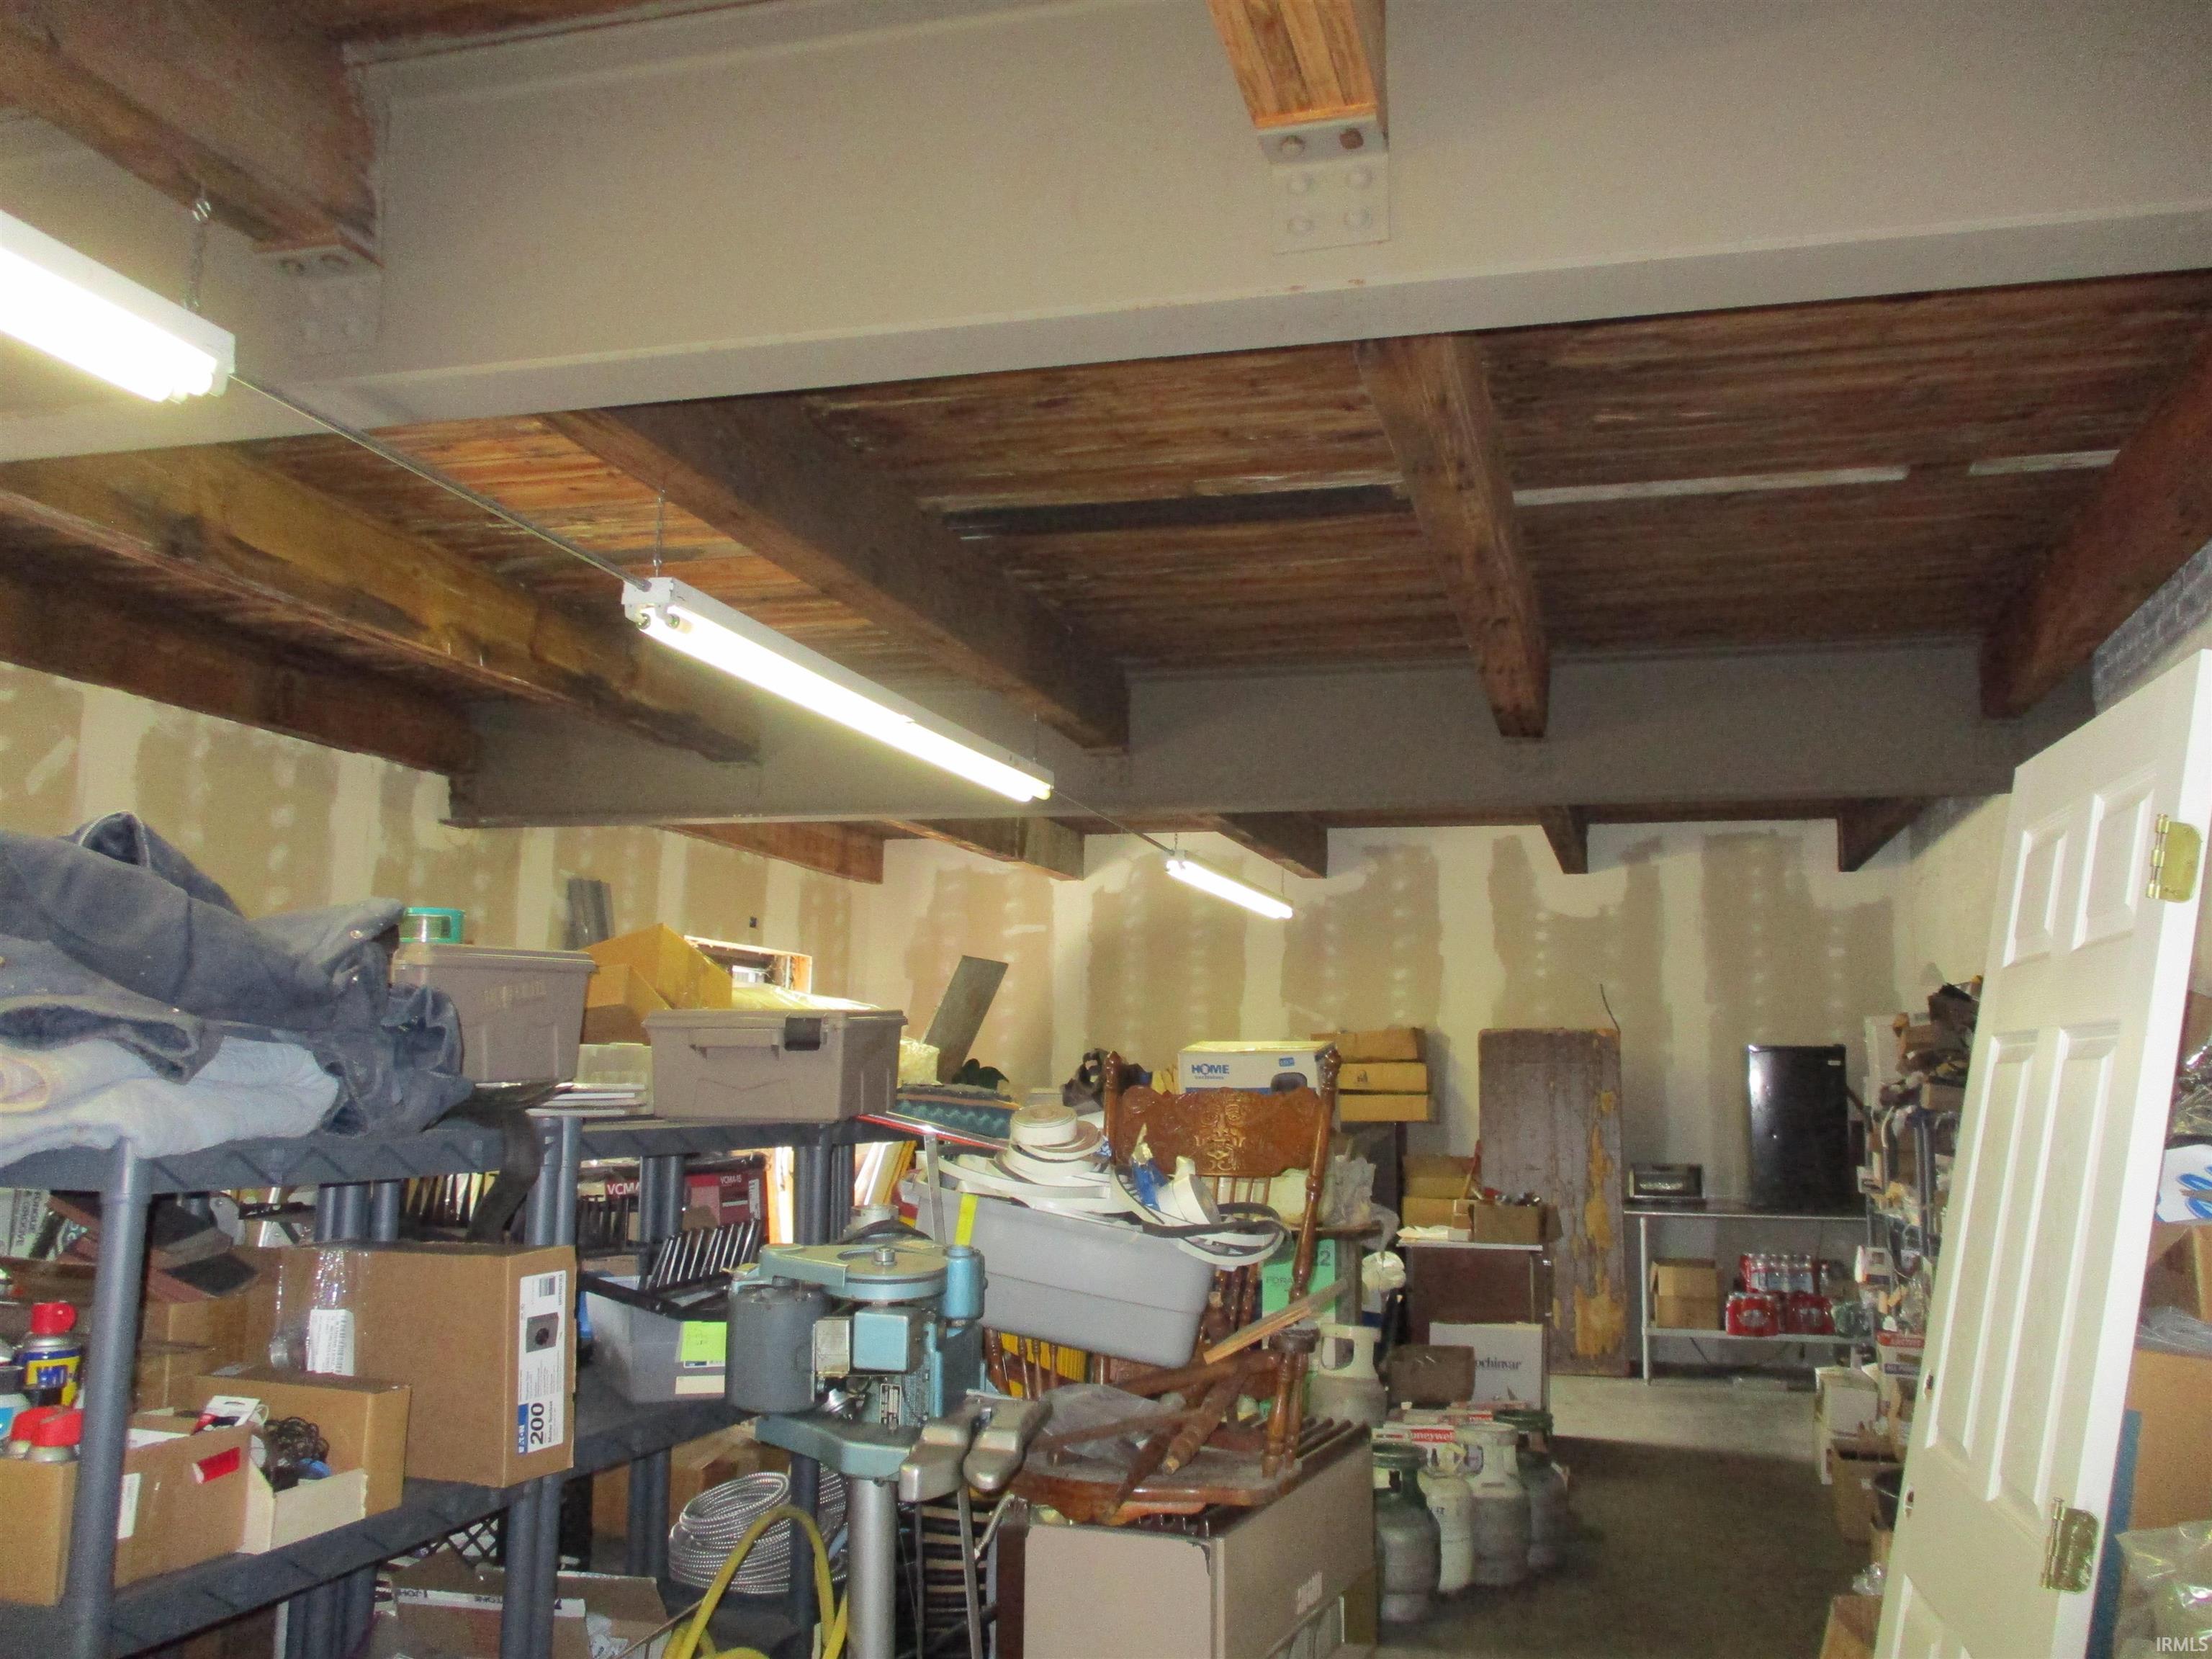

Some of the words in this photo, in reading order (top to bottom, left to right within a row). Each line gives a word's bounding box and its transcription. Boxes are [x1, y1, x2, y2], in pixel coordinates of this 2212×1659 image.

[1191, 1063, 1228, 1075] HOME
[1475, 1357, 1522, 1370] ochinvar
[530, 1402, 544, 1445] 200
[1413, 1431, 1452, 1441] oneywel
